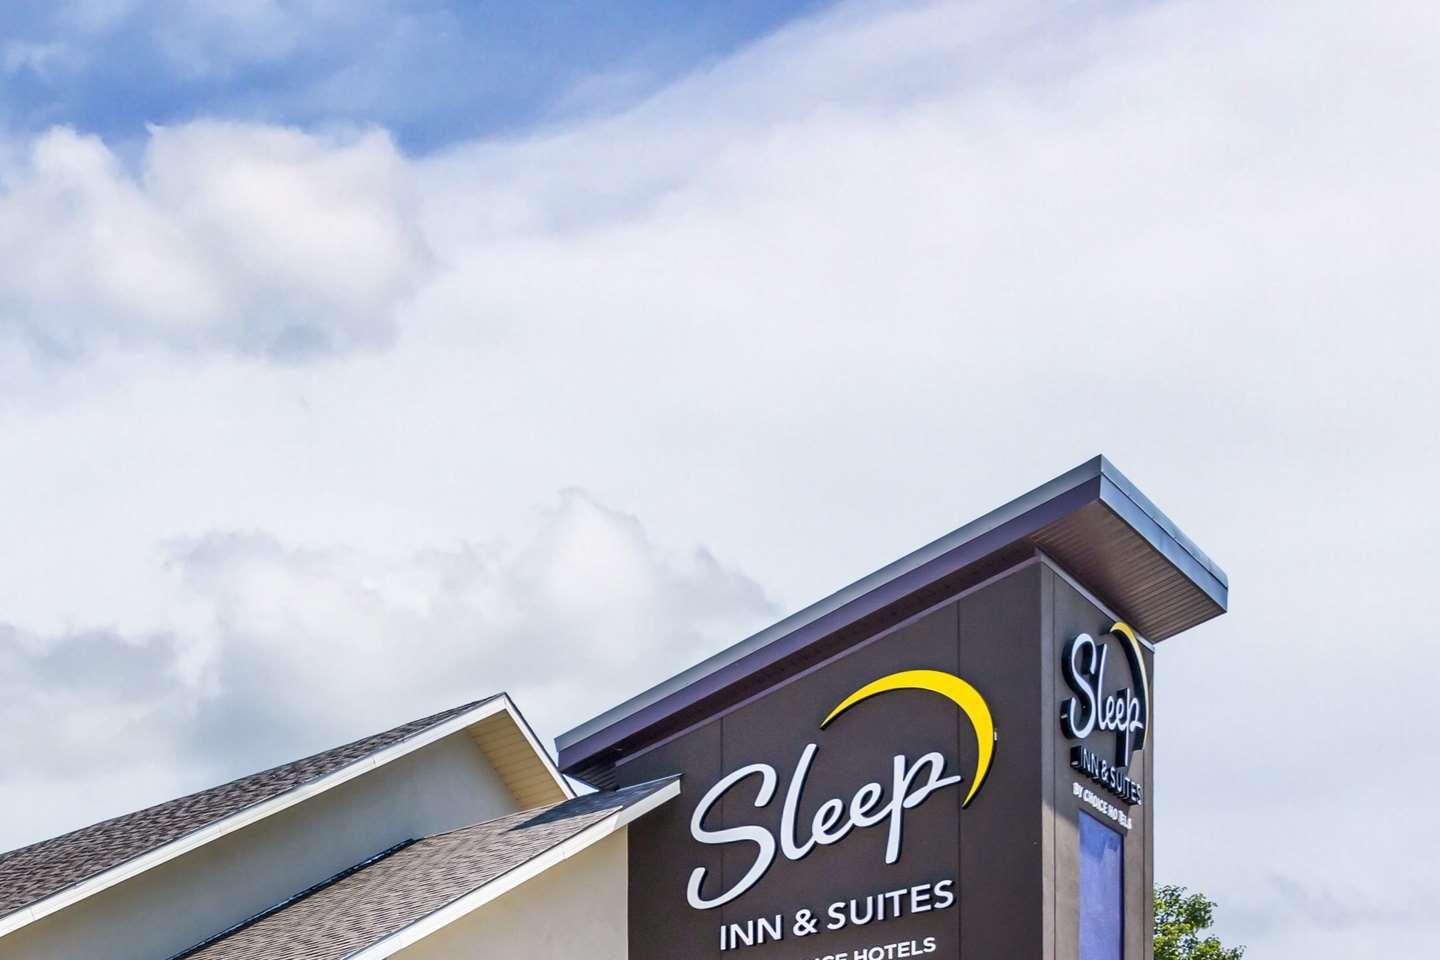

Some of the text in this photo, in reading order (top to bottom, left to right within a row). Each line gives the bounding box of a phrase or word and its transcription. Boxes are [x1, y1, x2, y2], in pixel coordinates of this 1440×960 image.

[1068, 632, 1144, 767] Sleep
[686, 743, 962, 910] Sleep
[1080, 746, 1144, 806] INN & SUITES
[719, 879, 955, 951] INN & SUITES
